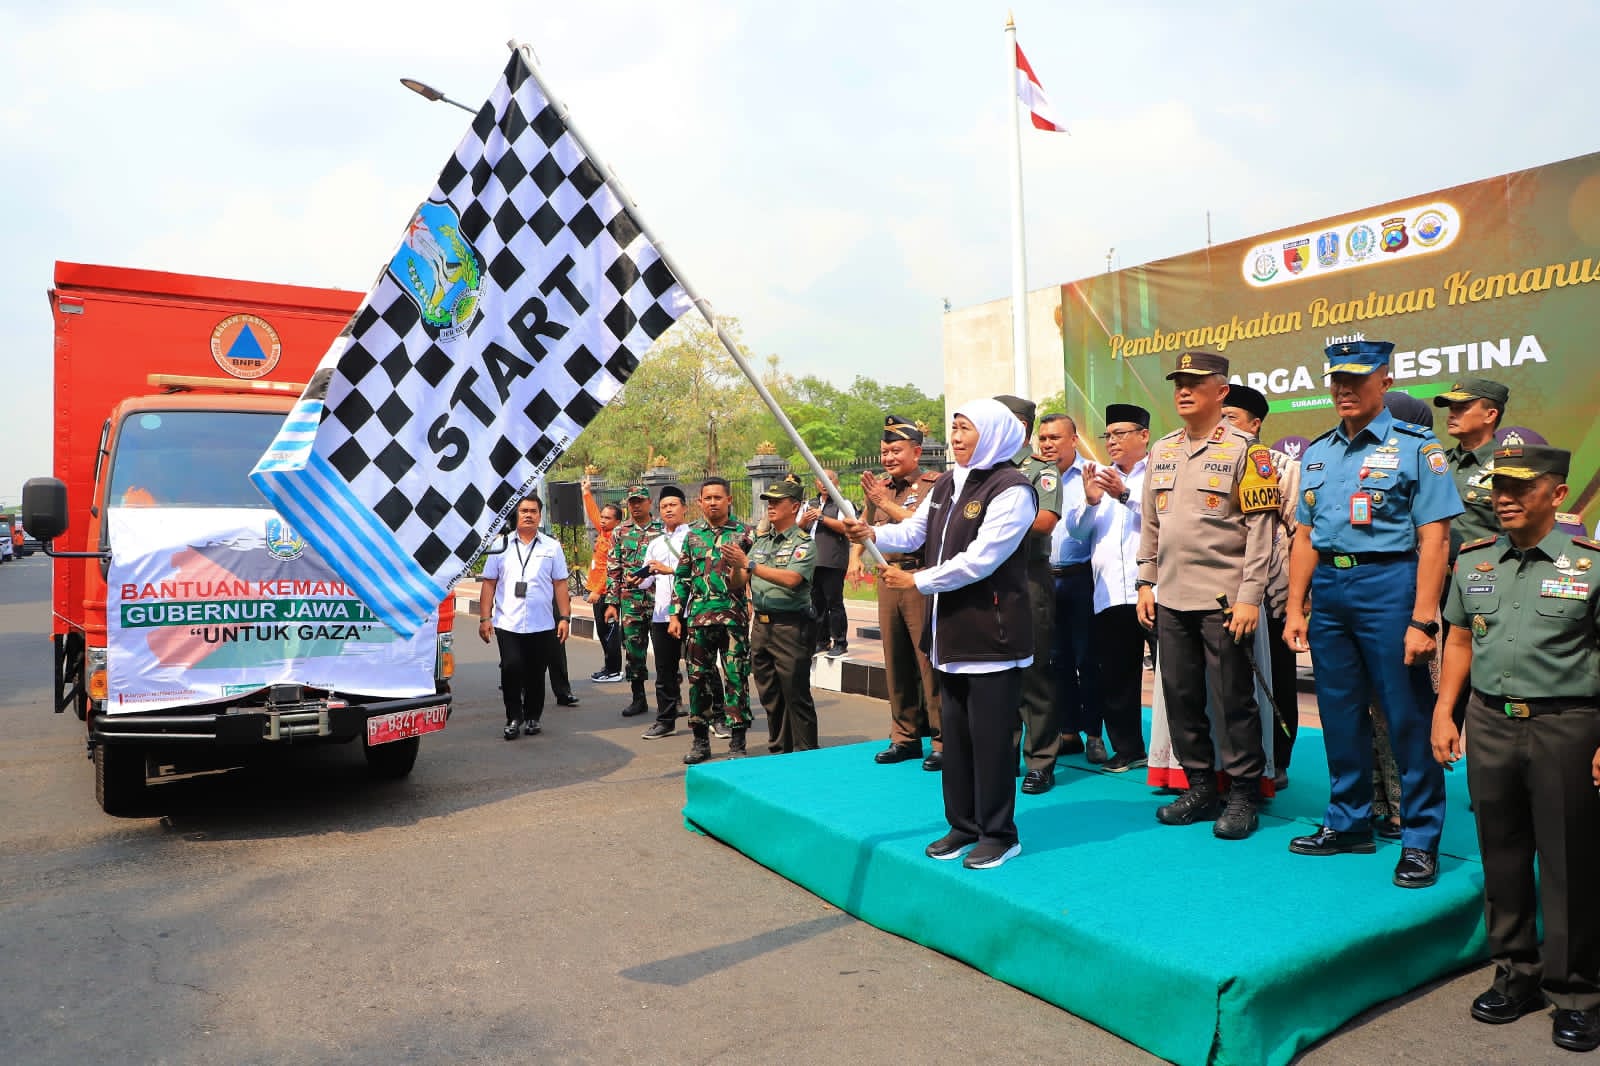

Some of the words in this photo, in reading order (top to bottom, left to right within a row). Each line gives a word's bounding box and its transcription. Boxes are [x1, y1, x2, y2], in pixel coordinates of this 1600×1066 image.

[1109, 311, 1302, 359] Pemberangkatan
[1308, 286, 1437, 328] Bantuan
[232, 358, 261, 367] BNPB
[427, 253, 590, 472] START
[1291, 397, 1333, 409] SURABAYA
[1203, 463, 1232, 473] POLRI
[488, 496, 519, 534] PROTOKOL
[517, 474, 537, 497] SETDA
[534, 456, 553, 476] PROV.
[552, 435, 570, 457] JATIM
[121, 580, 249, 600] BANTUAN
[126, 602, 277, 624] GUBERNUR
[283, 602, 350, 619] JAWA
[190, 624, 290, 644] “UNTUK
[297, 624, 372, 641] GAZA”
[369, 719, 377, 736] B
